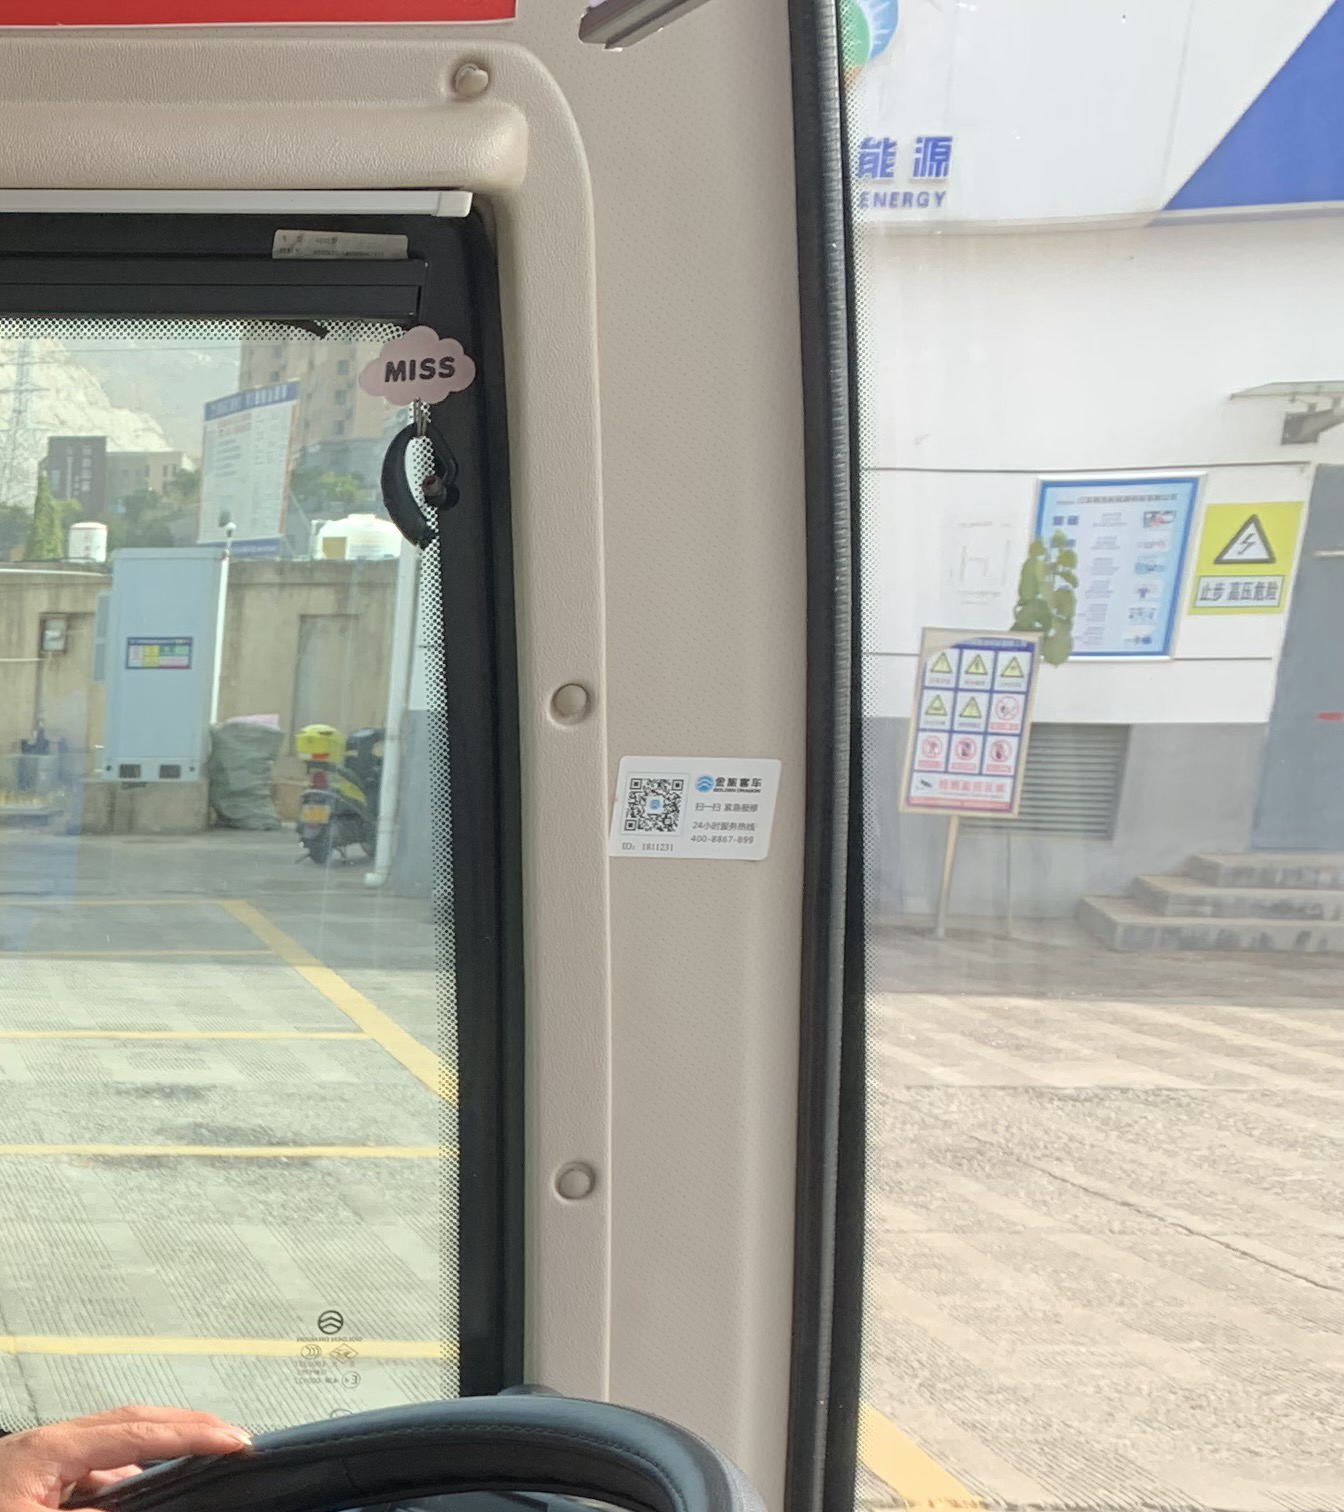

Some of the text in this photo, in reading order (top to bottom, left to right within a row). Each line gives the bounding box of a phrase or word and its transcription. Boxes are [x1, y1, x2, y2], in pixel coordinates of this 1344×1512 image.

[856, 136, 953, 178] 能源
[859, 191, 946, 209] ENERGY
[385, 356, 455, 382] MISS
[695, 802, 721, 812] 扫一扫
